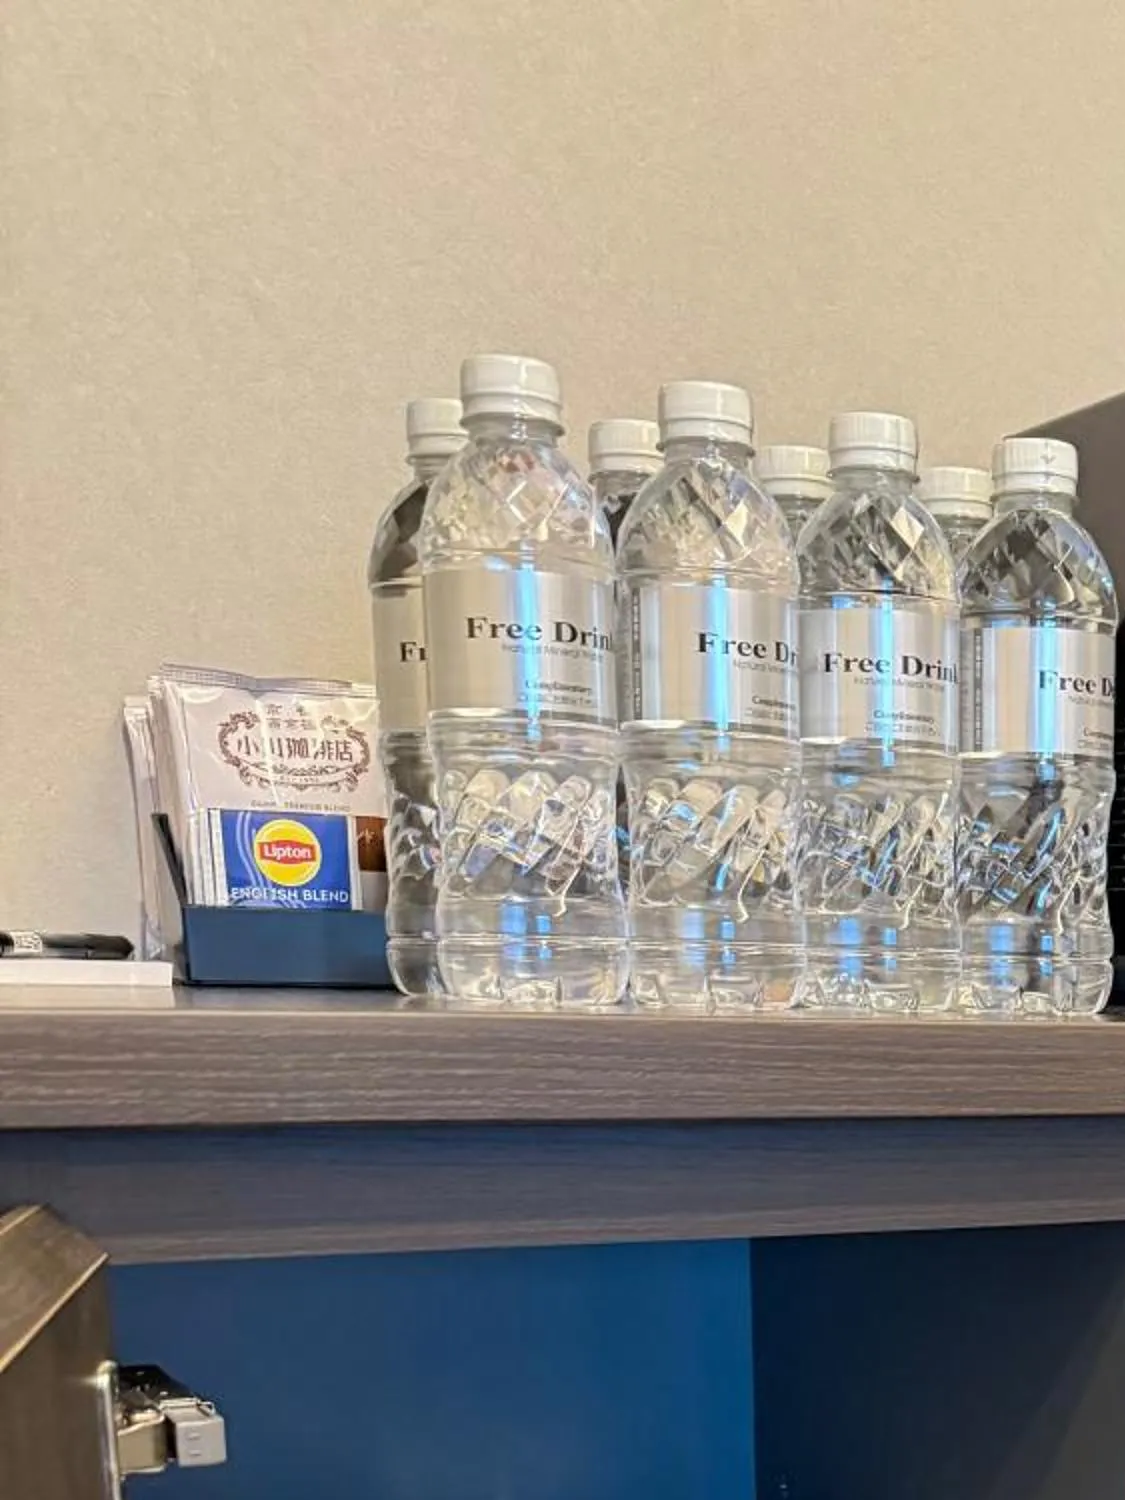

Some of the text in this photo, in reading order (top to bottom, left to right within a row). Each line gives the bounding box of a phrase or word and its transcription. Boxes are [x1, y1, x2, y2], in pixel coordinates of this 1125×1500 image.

[465, 616, 542, 641] Free
[696, 632, 766, 659] Free
[824, 652, 891, 674] Free
[1039, 670, 1097, 695] Free
[264, 843, 312, 861] Lipton
[231, 886, 349, 903] ENGLISH BLEND
